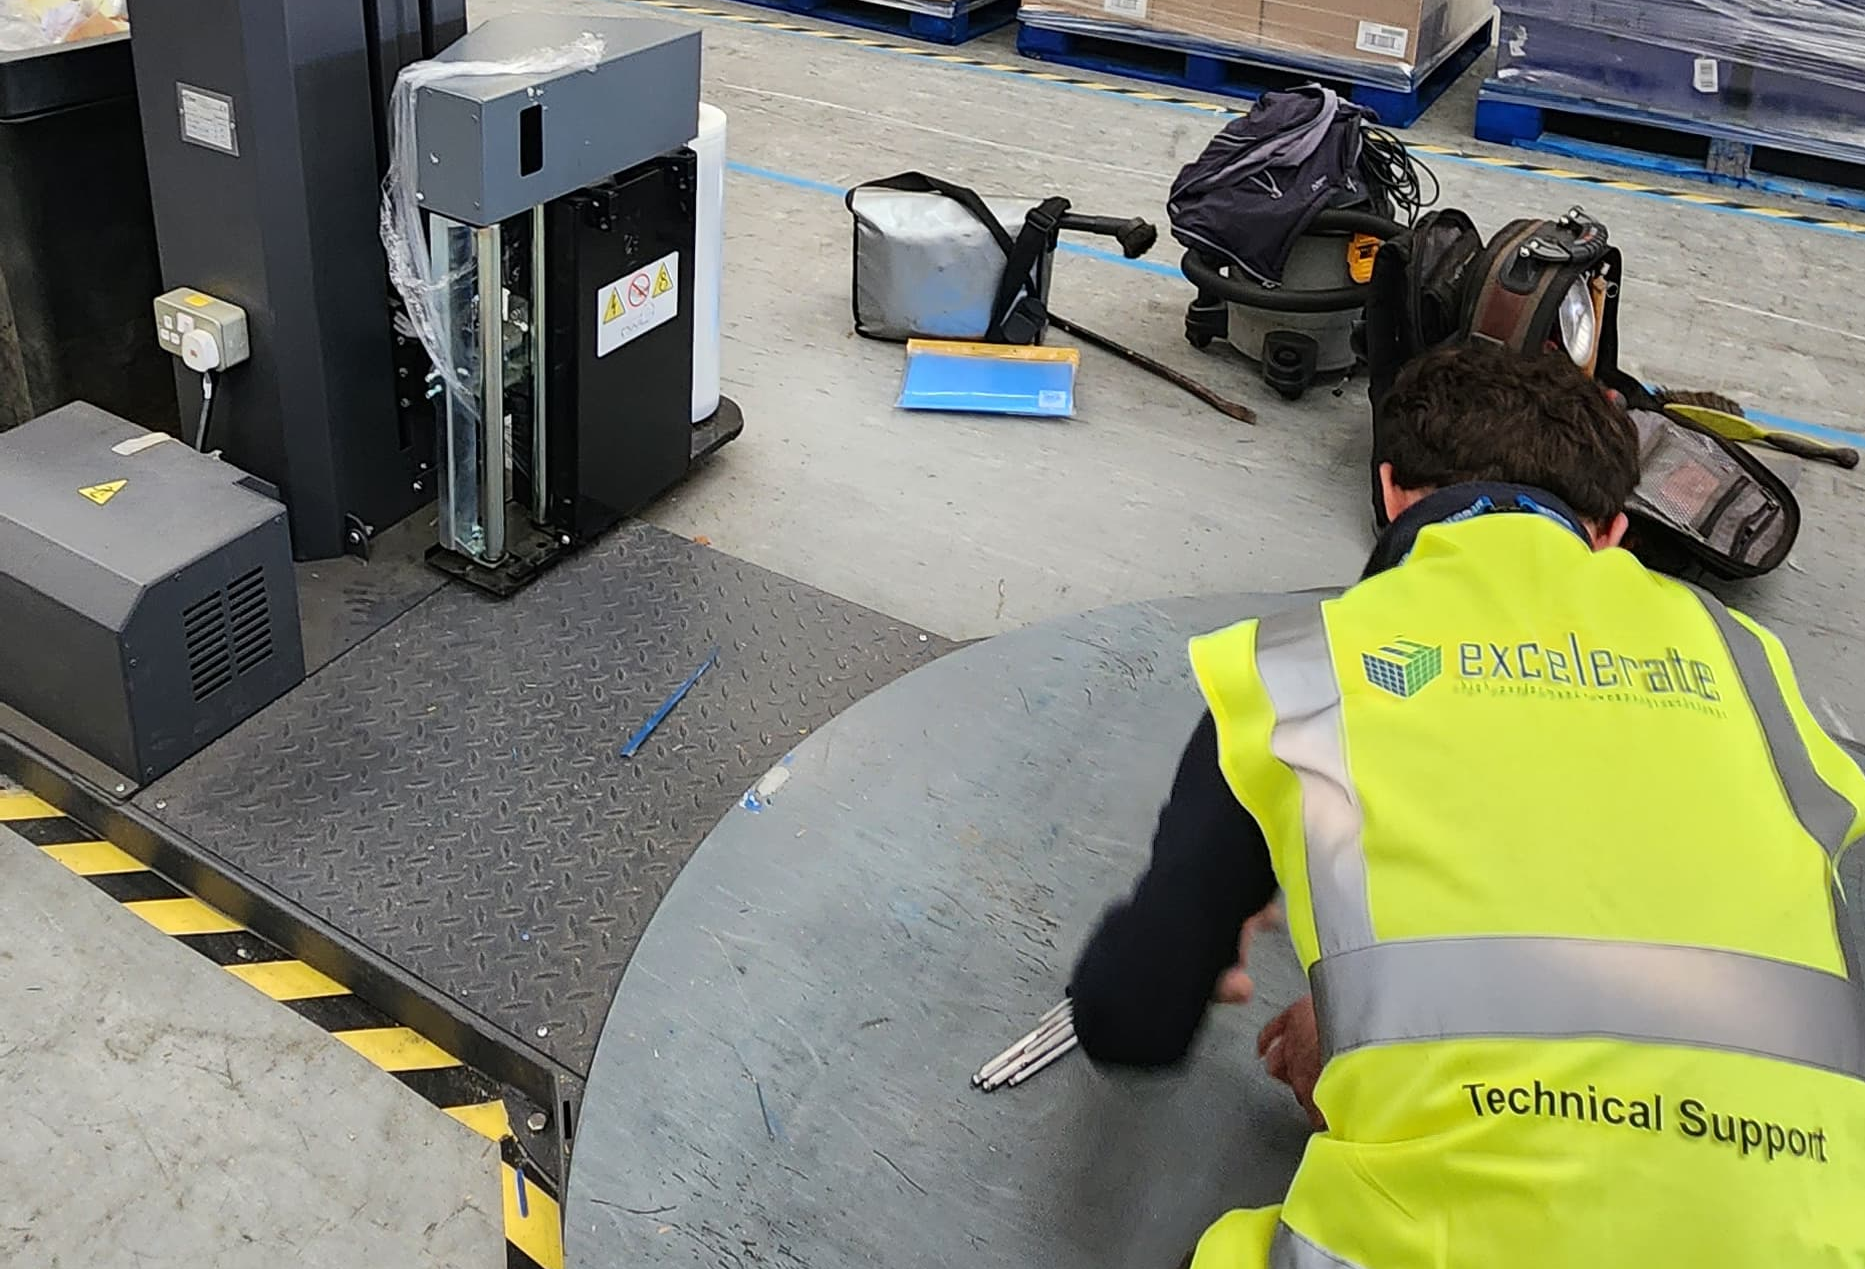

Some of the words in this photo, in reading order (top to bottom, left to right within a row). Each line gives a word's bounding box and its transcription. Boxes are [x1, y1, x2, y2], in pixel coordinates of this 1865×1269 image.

[1459, 631, 1722, 703] excelerate
[1461, 1079, 1663, 1132] Technical
[1678, 1098, 1829, 1163] Support
